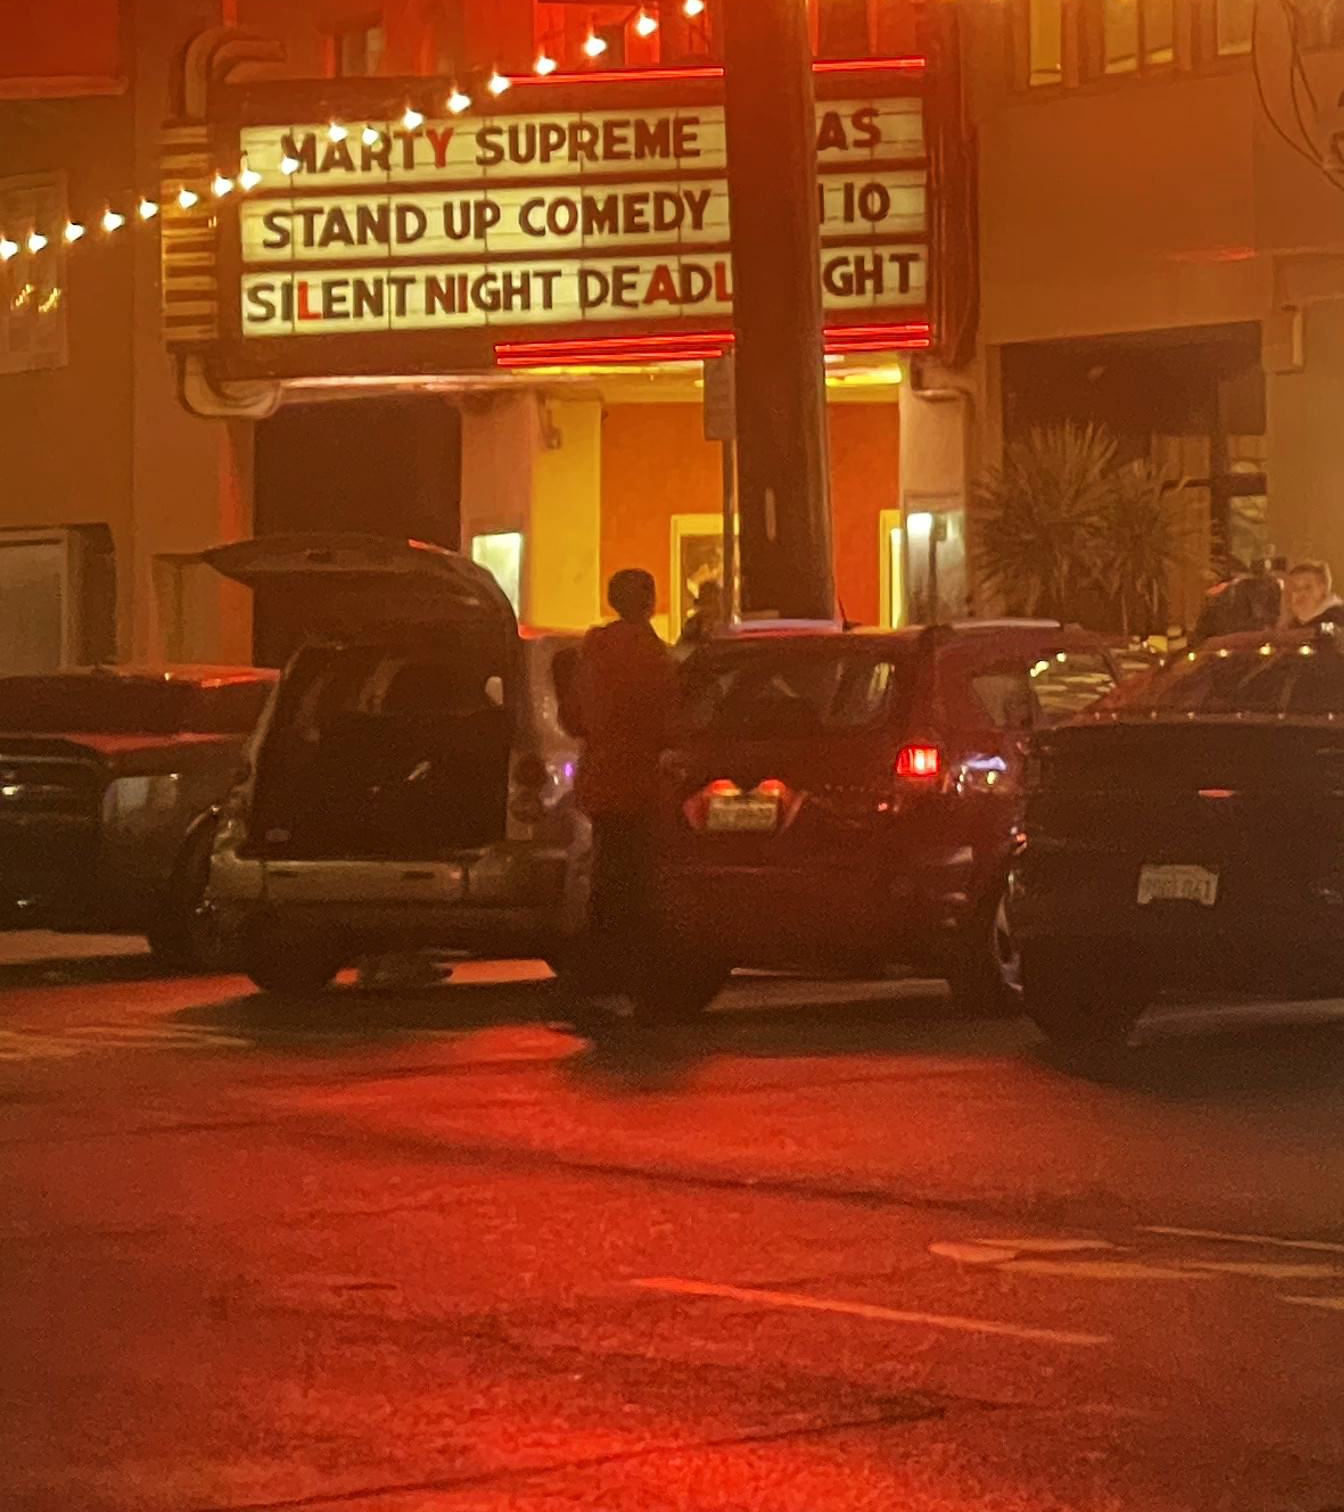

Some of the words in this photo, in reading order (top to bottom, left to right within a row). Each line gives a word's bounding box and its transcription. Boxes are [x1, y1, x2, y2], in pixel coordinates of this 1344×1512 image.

[280, 127, 454, 175] MARTY
[475, 116, 701, 166] SUPREME
[816, 107, 882, 151] AS
[262, 203, 428, 249] STAND
[443, 199, 501, 240] UP
[518, 189, 712, 237] COMEDY
[246, 275, 417, 323] SILENT
[425, 268, 563, 313] NIGHT
[577, 261, 734, 309] DEADL
[822, 252, 920, 297] GHT
